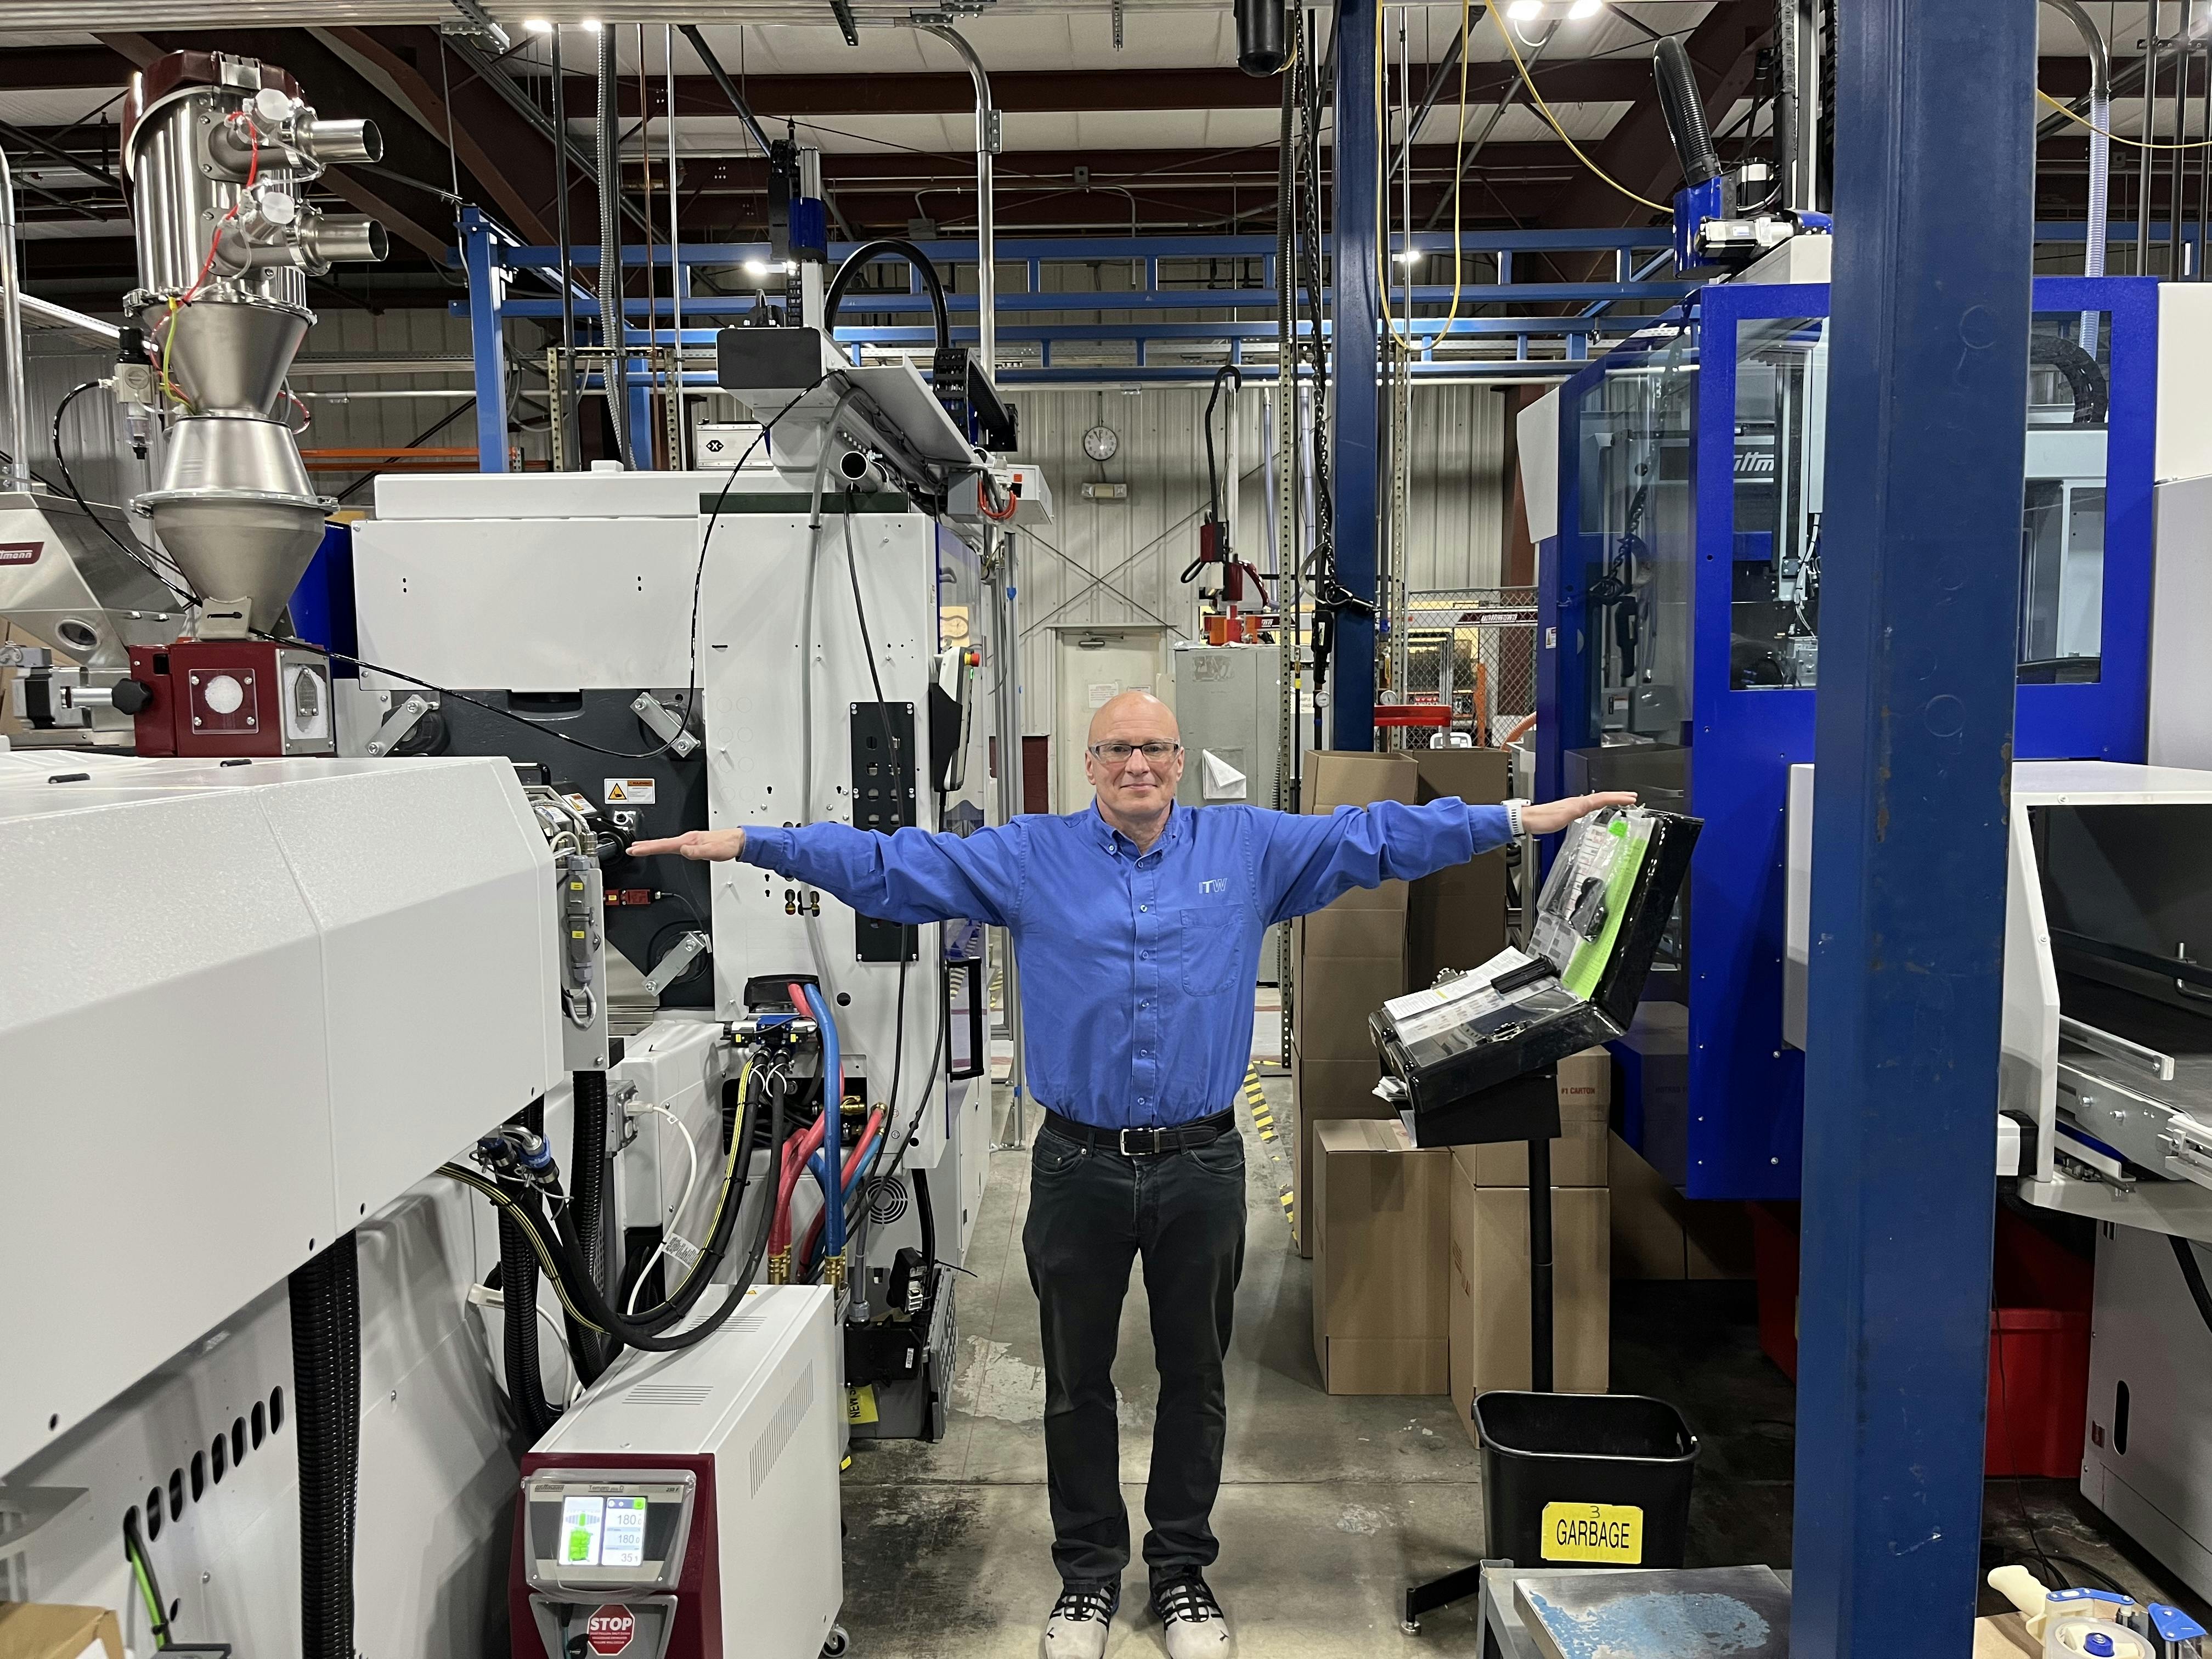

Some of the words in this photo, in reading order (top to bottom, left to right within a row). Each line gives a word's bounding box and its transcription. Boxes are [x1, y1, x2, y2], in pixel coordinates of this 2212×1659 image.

[1199, 878, 1228, 894] ITW
[850, 1398, 861, 1418] NEW
[1590, 1505, 1600, 1519] 3
[1557, 1519, 1630, 1549] GARBAGE
[590, 1617, 633, 1631] STOP
